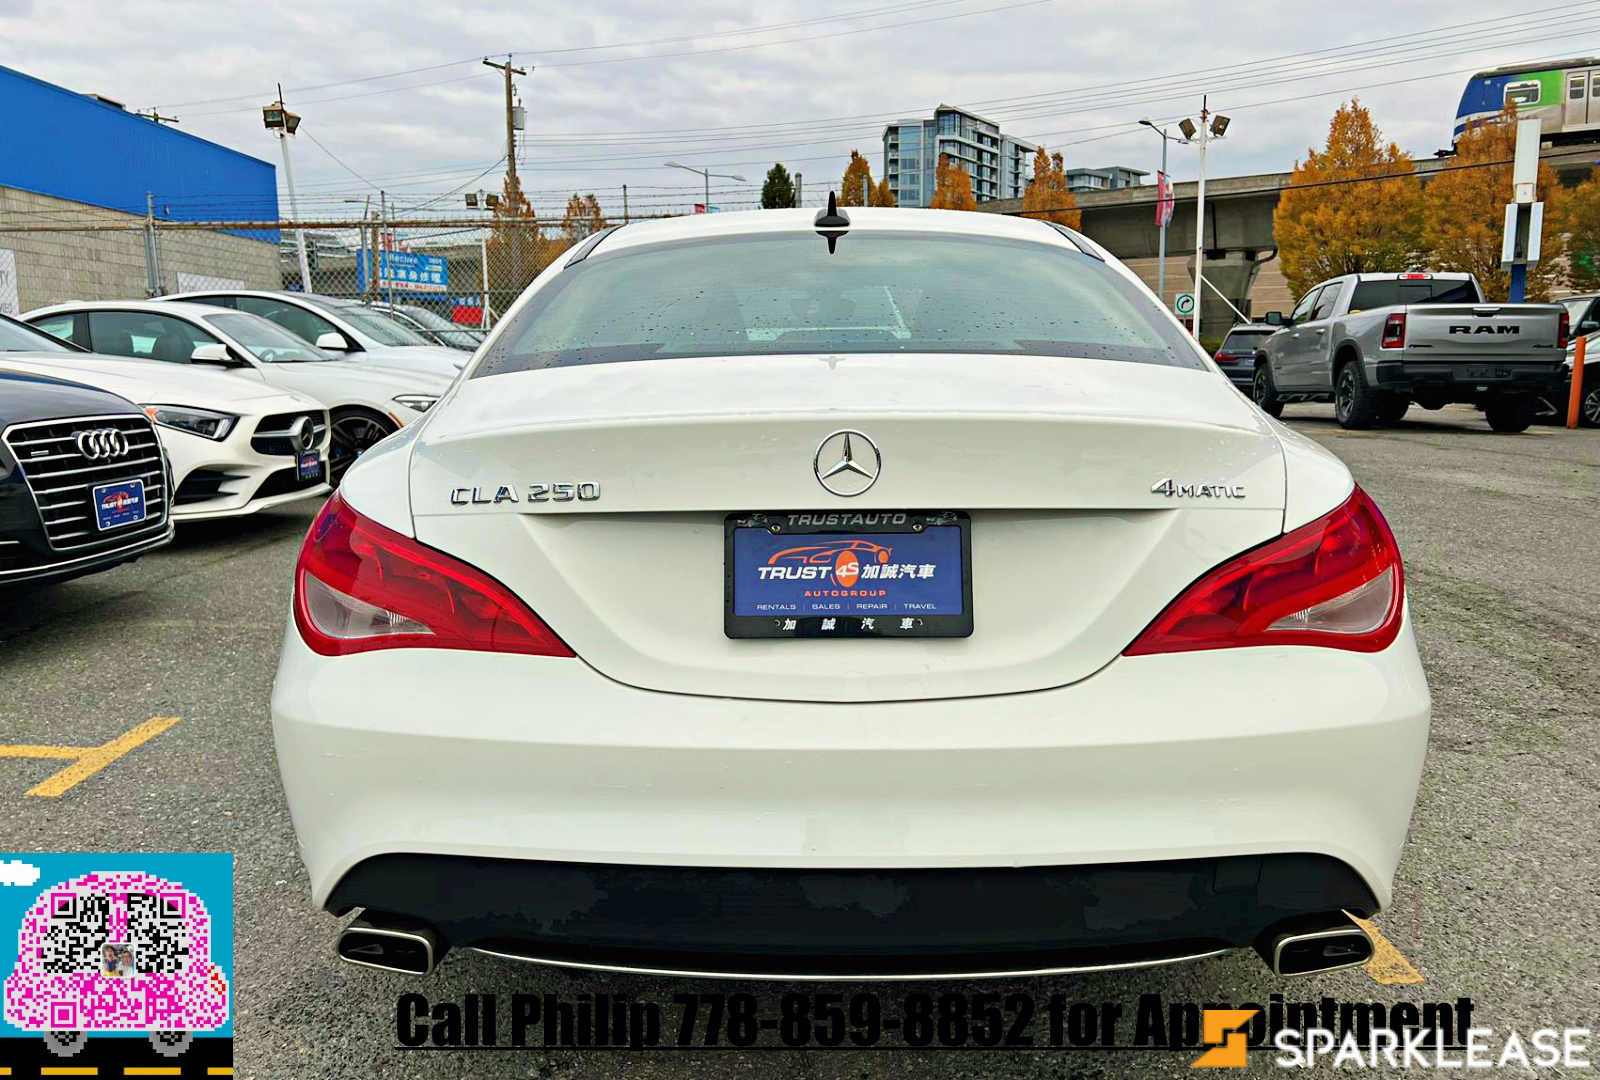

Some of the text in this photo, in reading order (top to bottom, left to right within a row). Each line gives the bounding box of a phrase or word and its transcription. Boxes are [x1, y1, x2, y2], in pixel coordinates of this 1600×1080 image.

[1449, 325, 1520, 335] RAM
[450, 480, 600, 505] CLA 250
[1151, 478, 1246, 499] 4MATIC
[787, 513, 907, 526] TRUSTAUTO
[758, 561, 936, 579] TRUST 4S 加誠汽車
[756, 603, 797, 611] RENTALS
